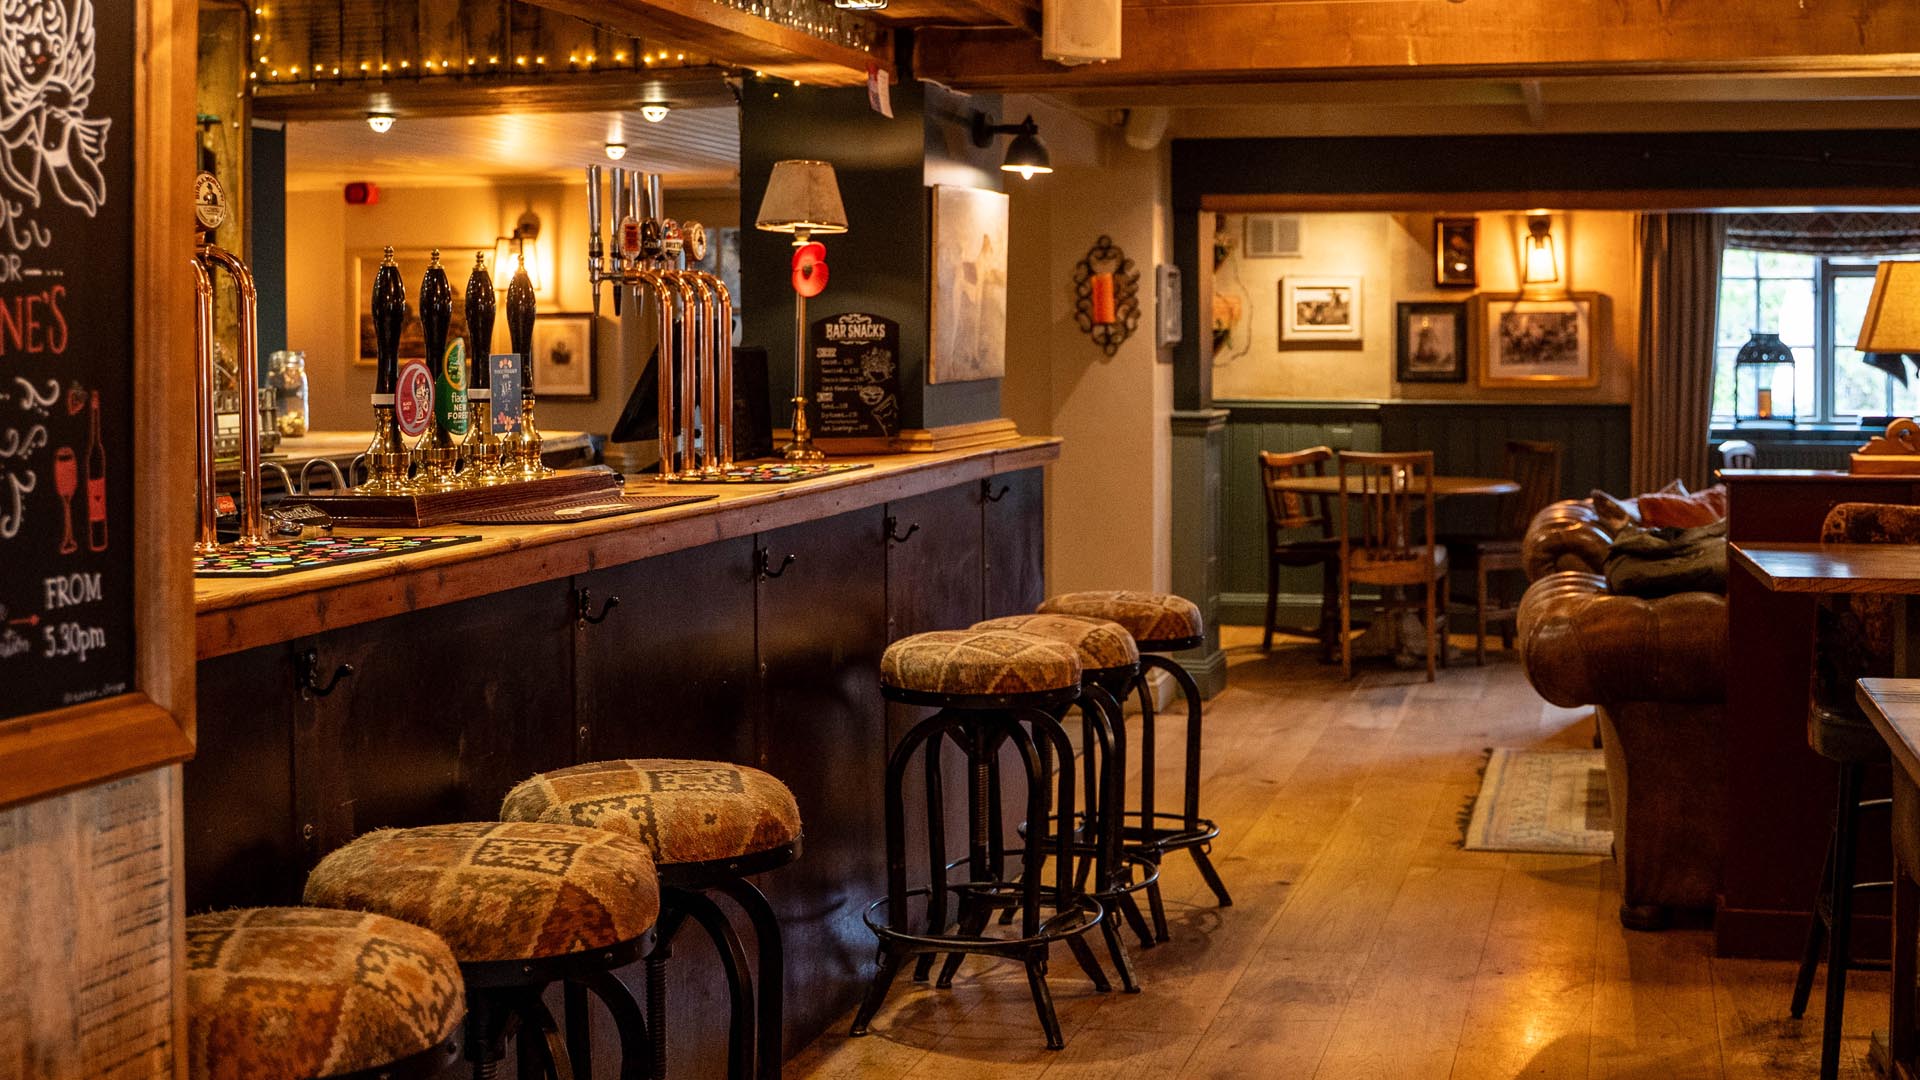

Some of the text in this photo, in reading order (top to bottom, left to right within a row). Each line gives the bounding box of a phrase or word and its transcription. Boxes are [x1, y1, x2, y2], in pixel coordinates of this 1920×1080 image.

[825, 323, 886, 339] BAR SNACKS
[44, 572, 103, 610] FROM
[44, 622, 106, 662] 5.30pm
